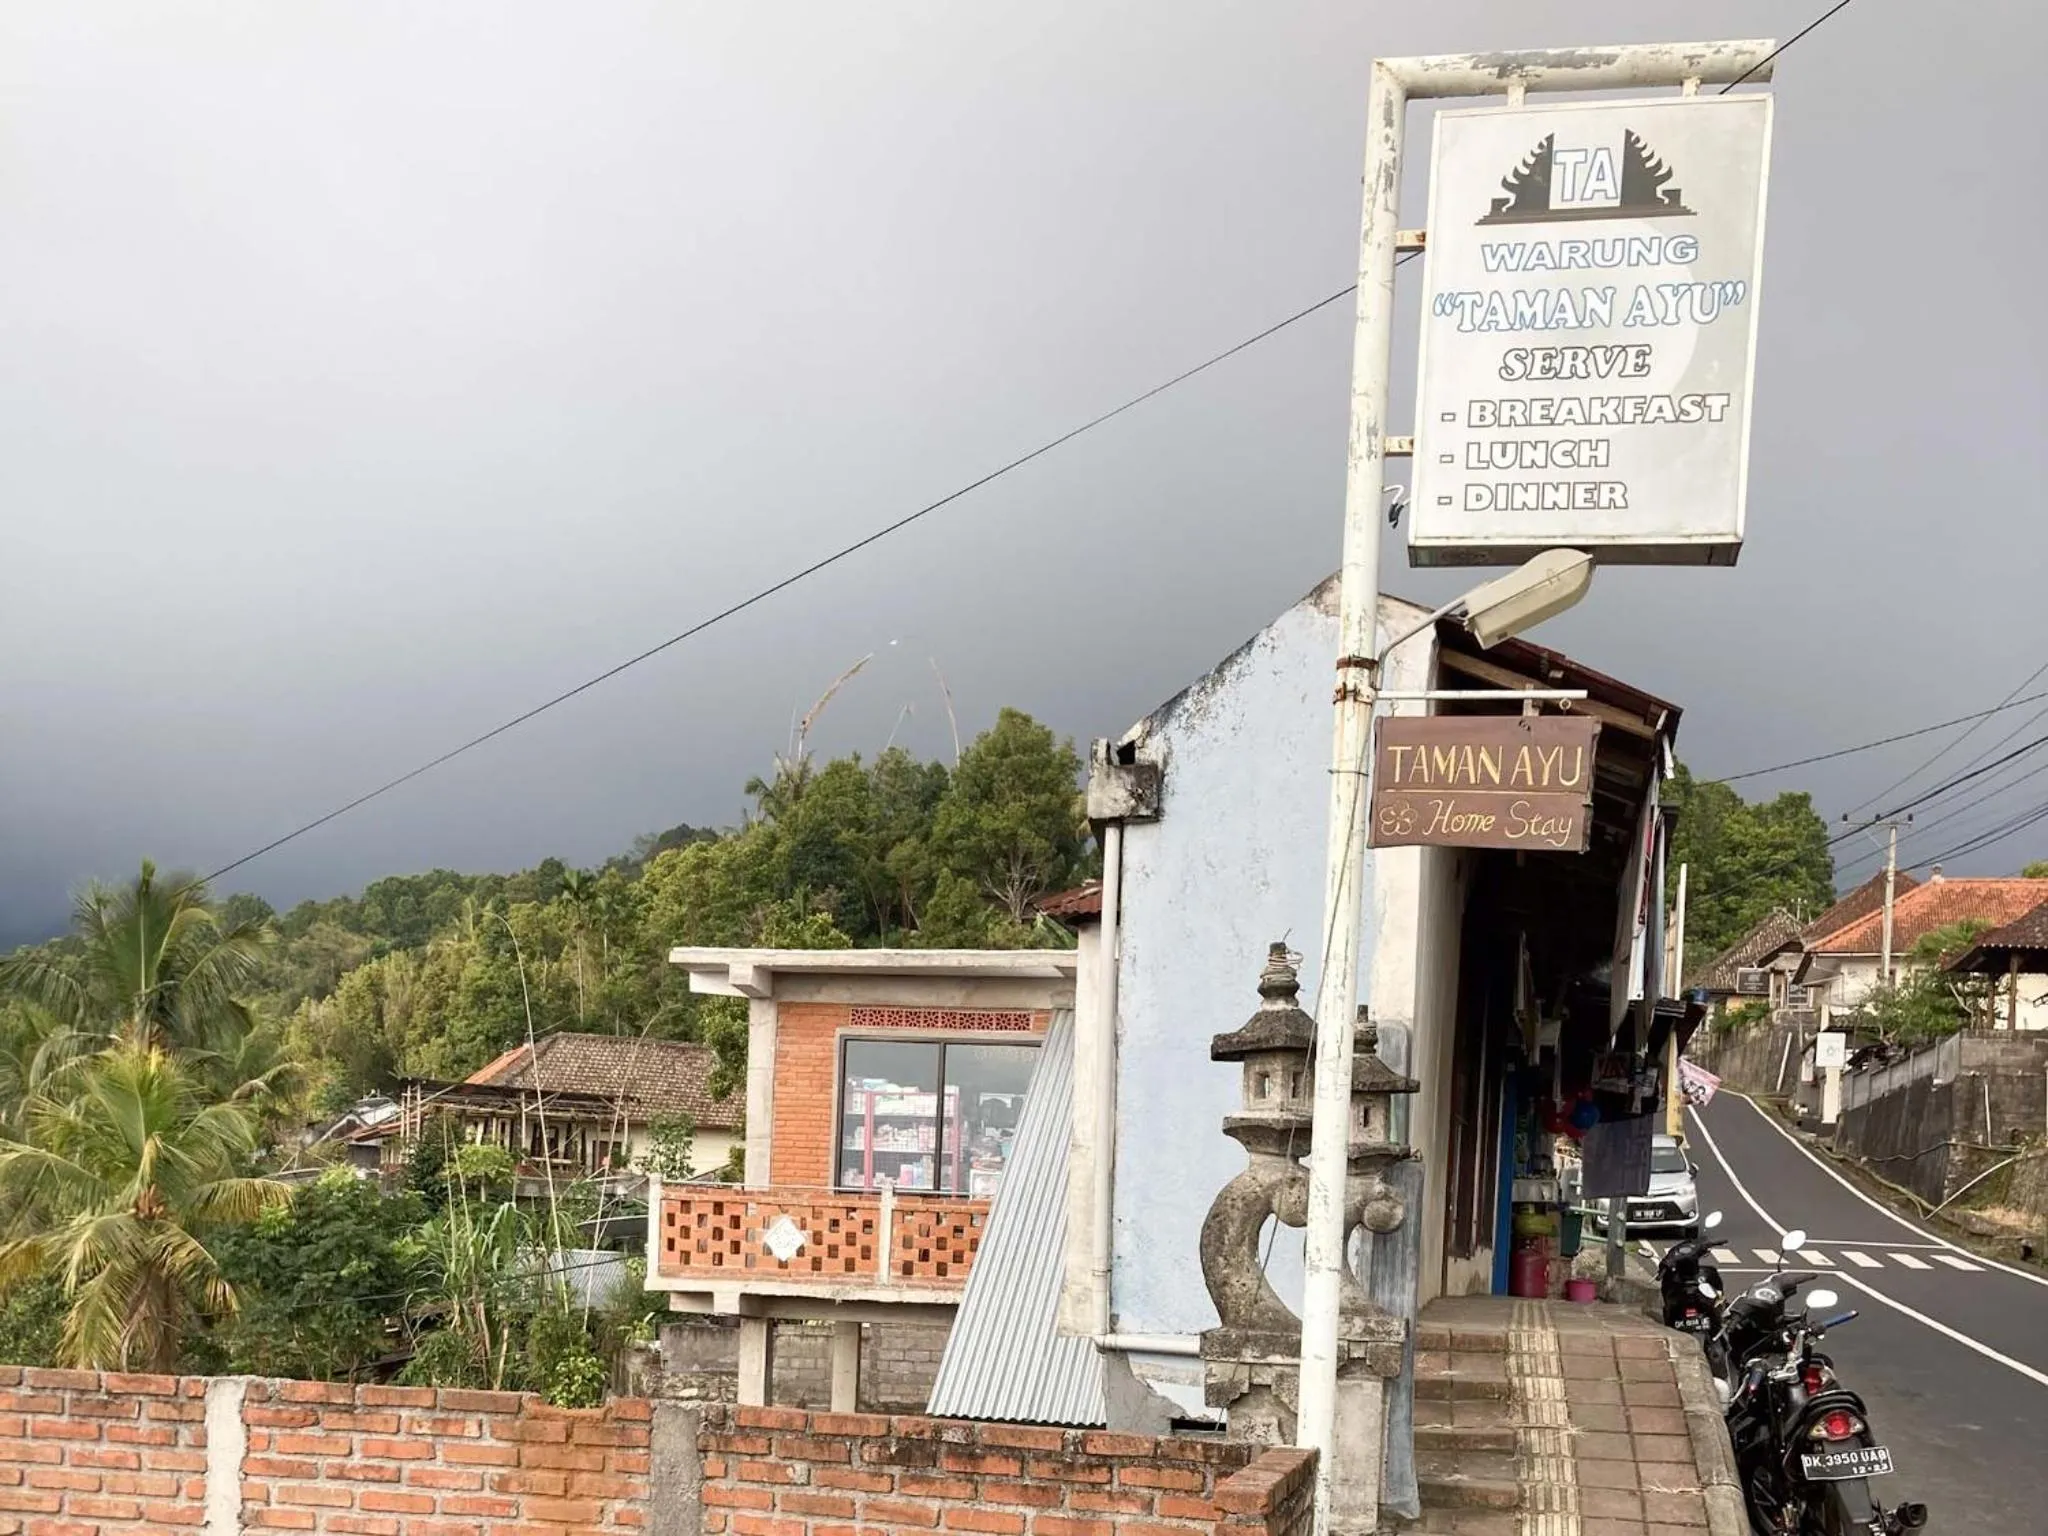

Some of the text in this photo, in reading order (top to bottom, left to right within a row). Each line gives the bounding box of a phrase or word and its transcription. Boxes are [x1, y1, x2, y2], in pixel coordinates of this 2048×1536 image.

[1552, 148, 1620, 202] TA
[1481, 235, 1699, 272] WARUNG
[1498, 344, 1652, 381] SERVE
[1467, 393, 1731, 428] BREAKFAST
[1465, 439, 1610, 471] LUNCH
[1464, 481, 1629, 511] DINNER
[1386, 745, 1583, 787] TAMAN AYU
[1422, 799, 1573, 847] Home Stay
[1825, 1452, 1859, 1466] 3950
